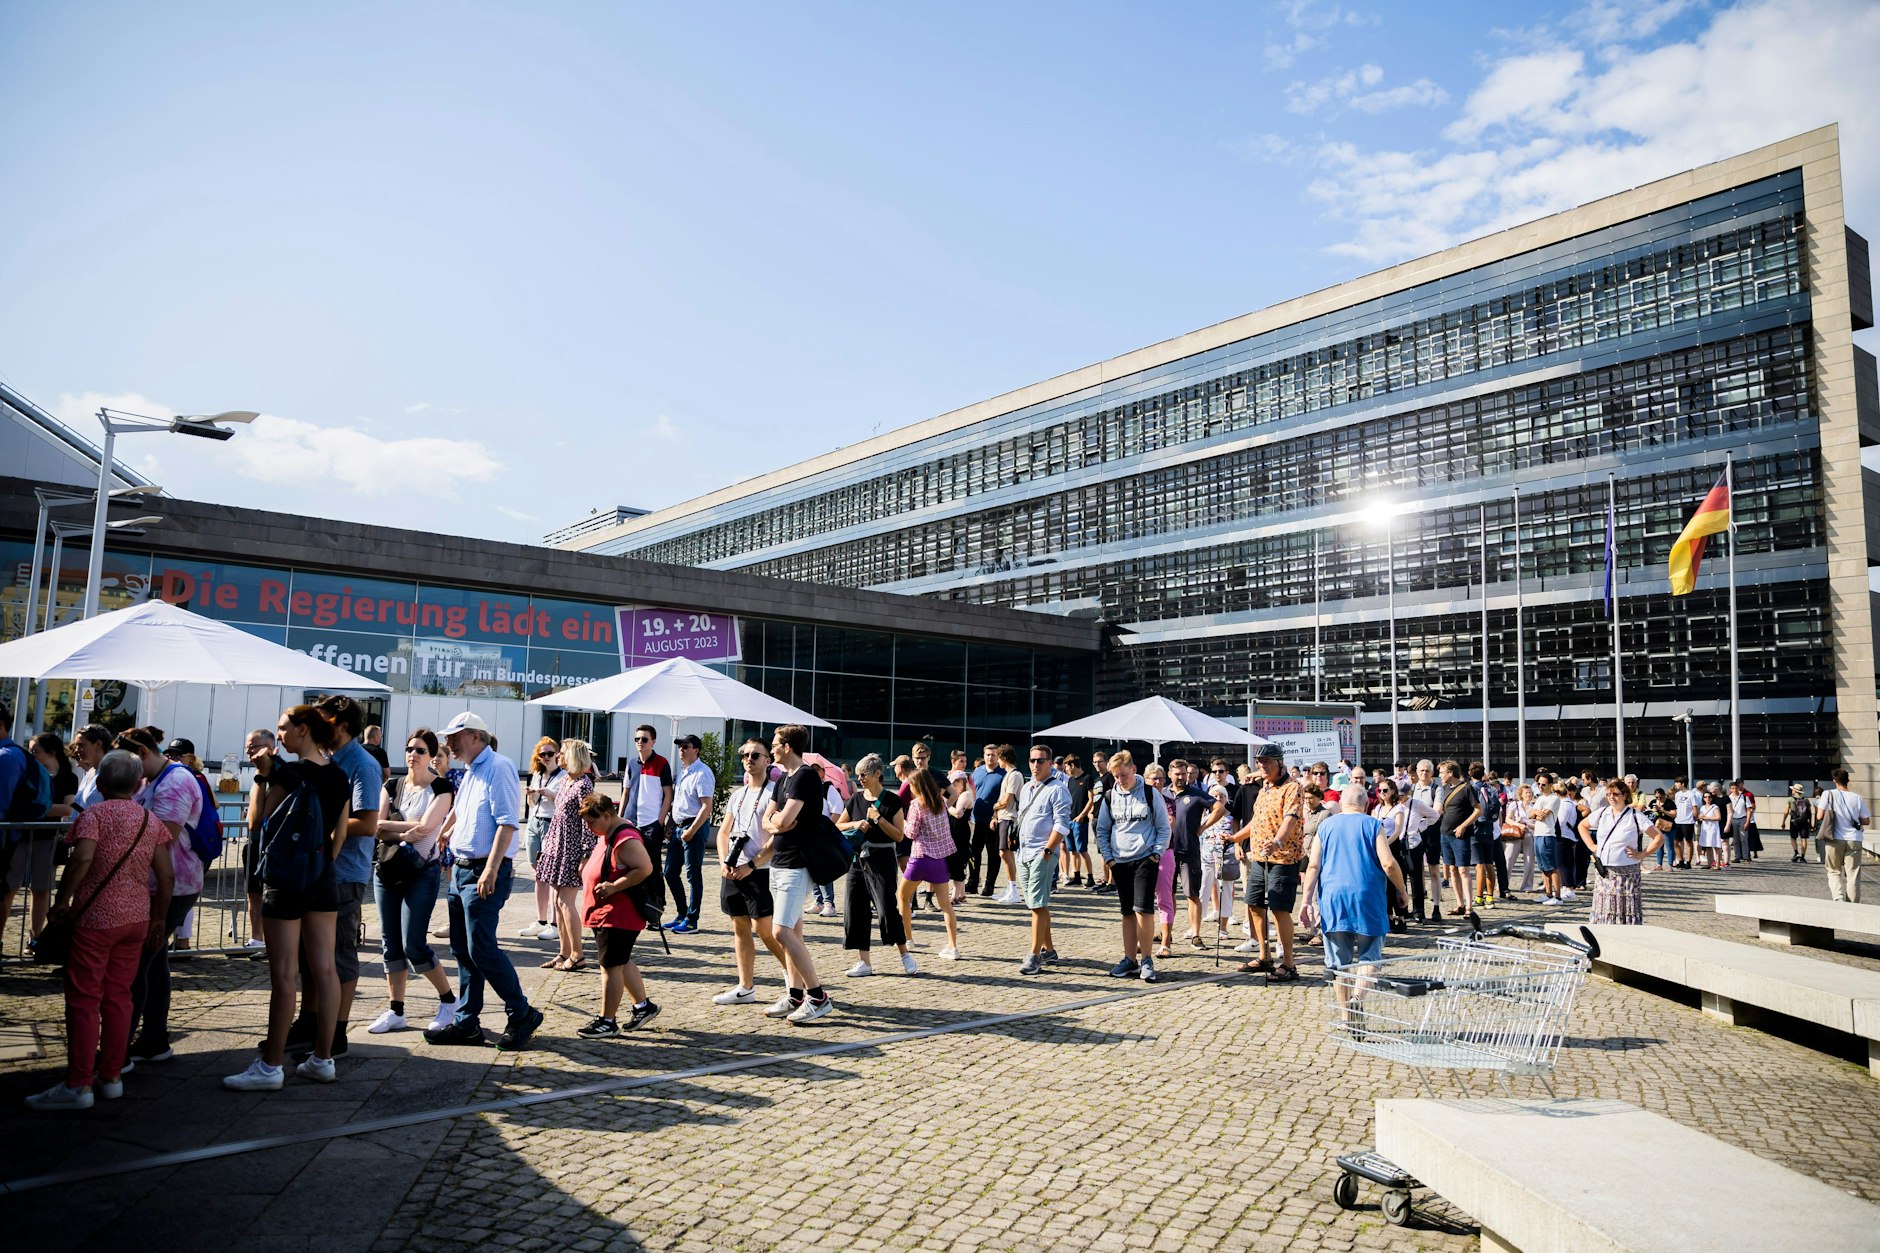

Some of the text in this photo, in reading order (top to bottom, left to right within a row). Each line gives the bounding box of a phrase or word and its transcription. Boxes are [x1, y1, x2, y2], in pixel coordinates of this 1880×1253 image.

[161, 569, 612, 643] Die Regierung lädt ein
[642, 613, 717, 637] 19. + 20.
[644, 635, 719, 654] AUGUST 2023
[294, 643, 408, 674] ffenen
[416, 651, 465, 678] Tür
[472, 665, 493, 681] im
